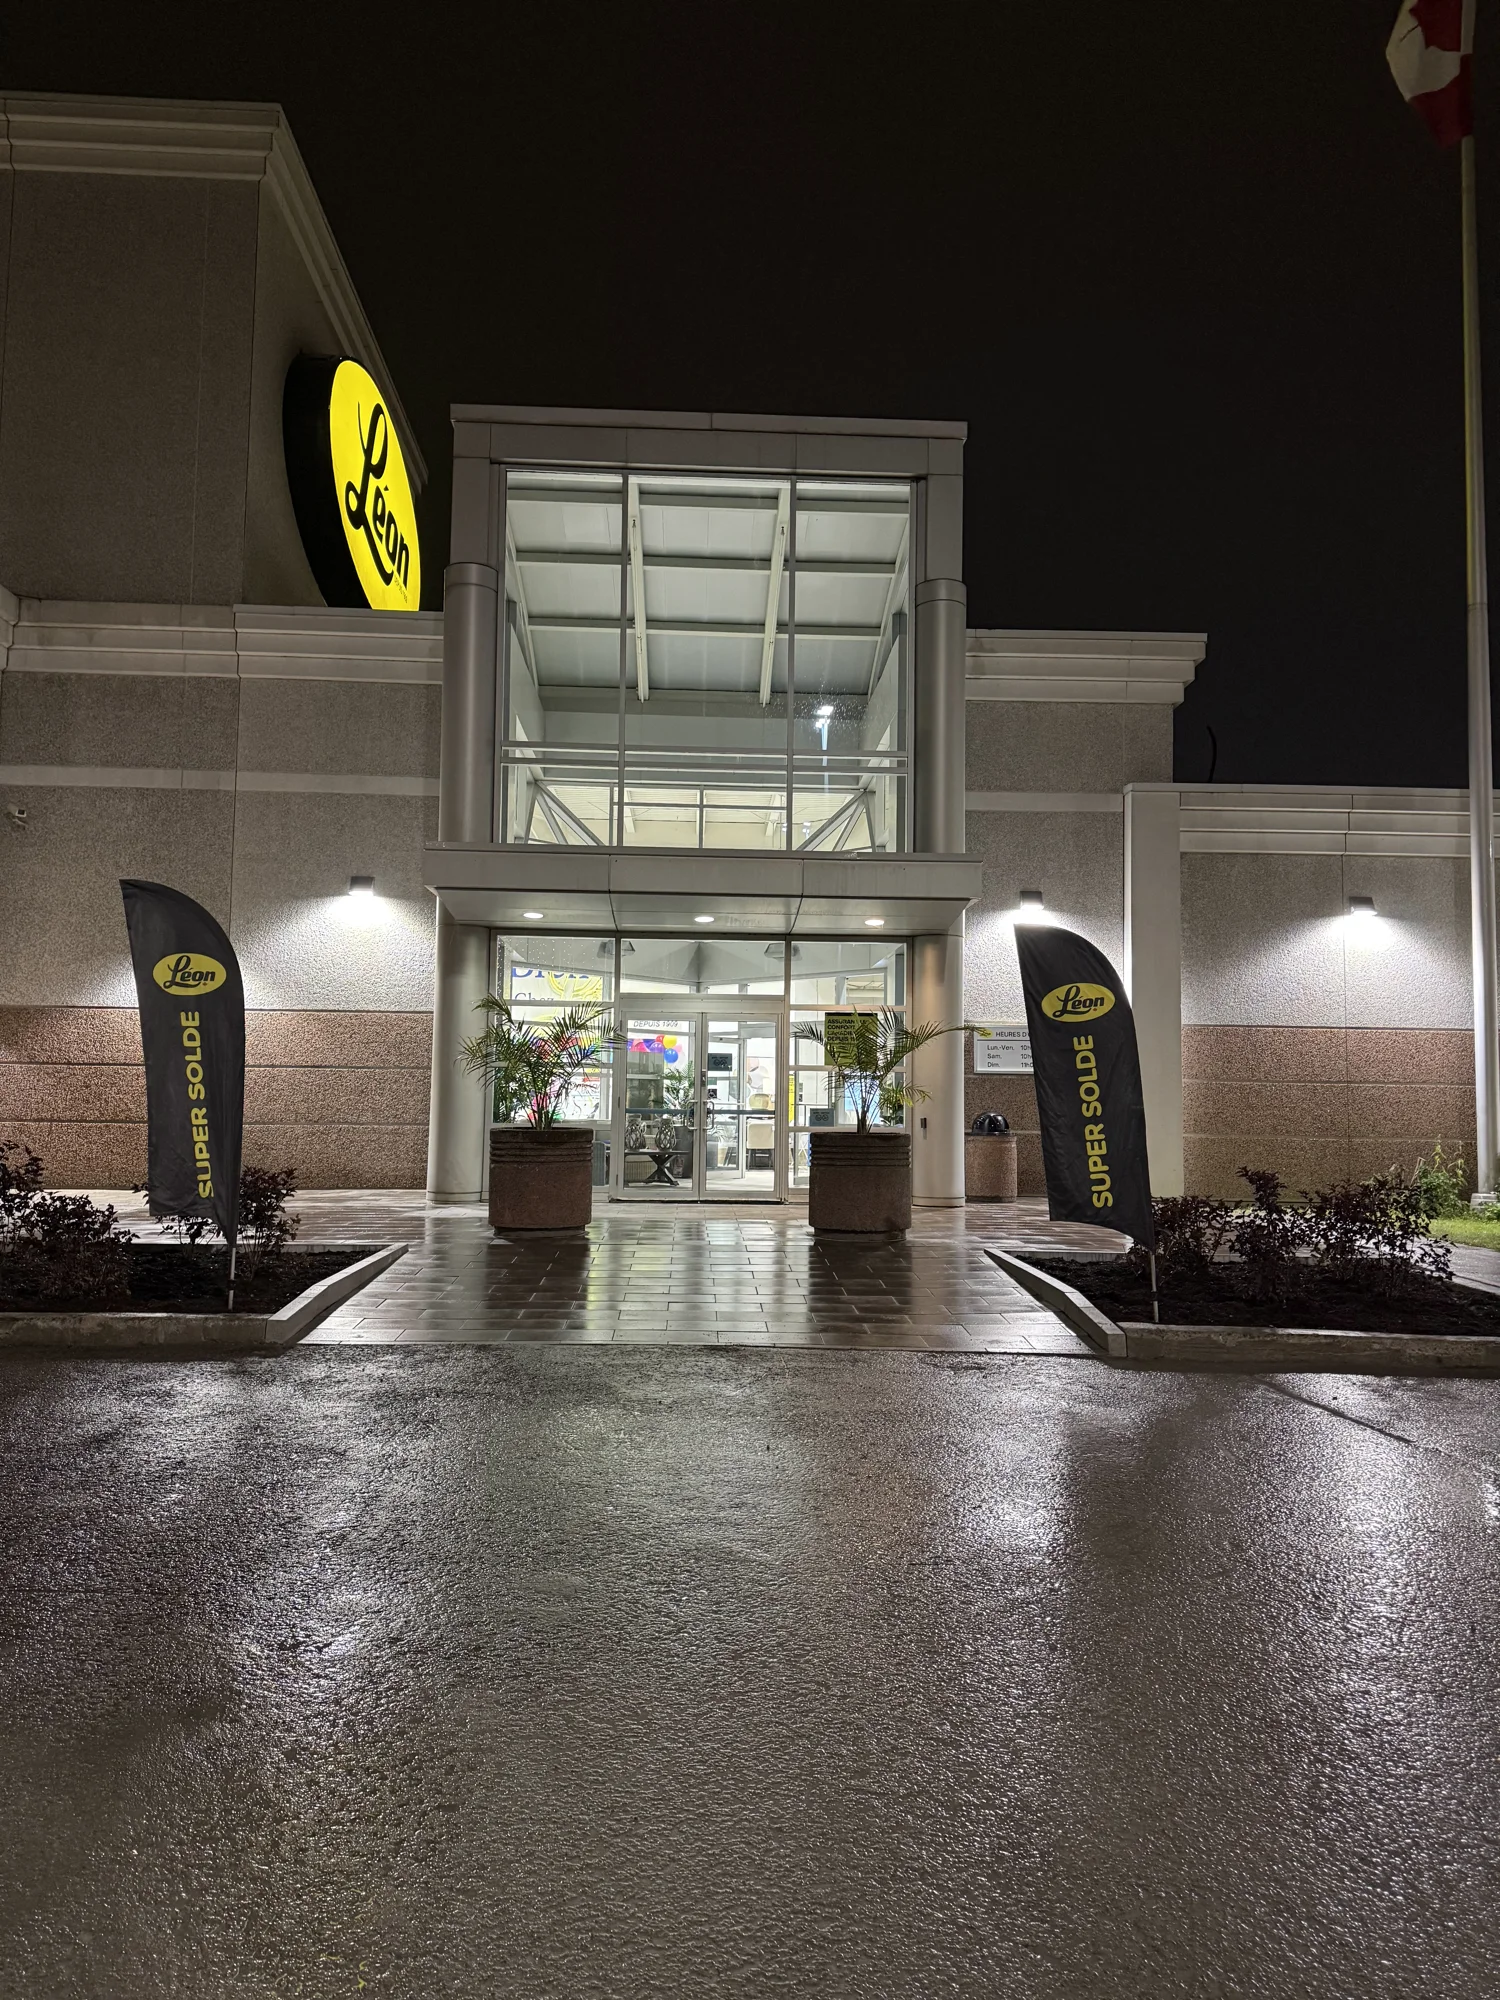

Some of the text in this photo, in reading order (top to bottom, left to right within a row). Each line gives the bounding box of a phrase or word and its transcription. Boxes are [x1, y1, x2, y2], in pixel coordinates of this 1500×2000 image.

[345, 401, 410, 589] Léon
[163, 955, 216, 989] Léon
[633, 1020, 661, 1028] DEPUIS
[1053, 985, 1105, 1018] Léon
[180, 1011, 214, 1199] SUPER SOLDE
[1073, 1034, 1113, 1208] SUPER SOLDE
